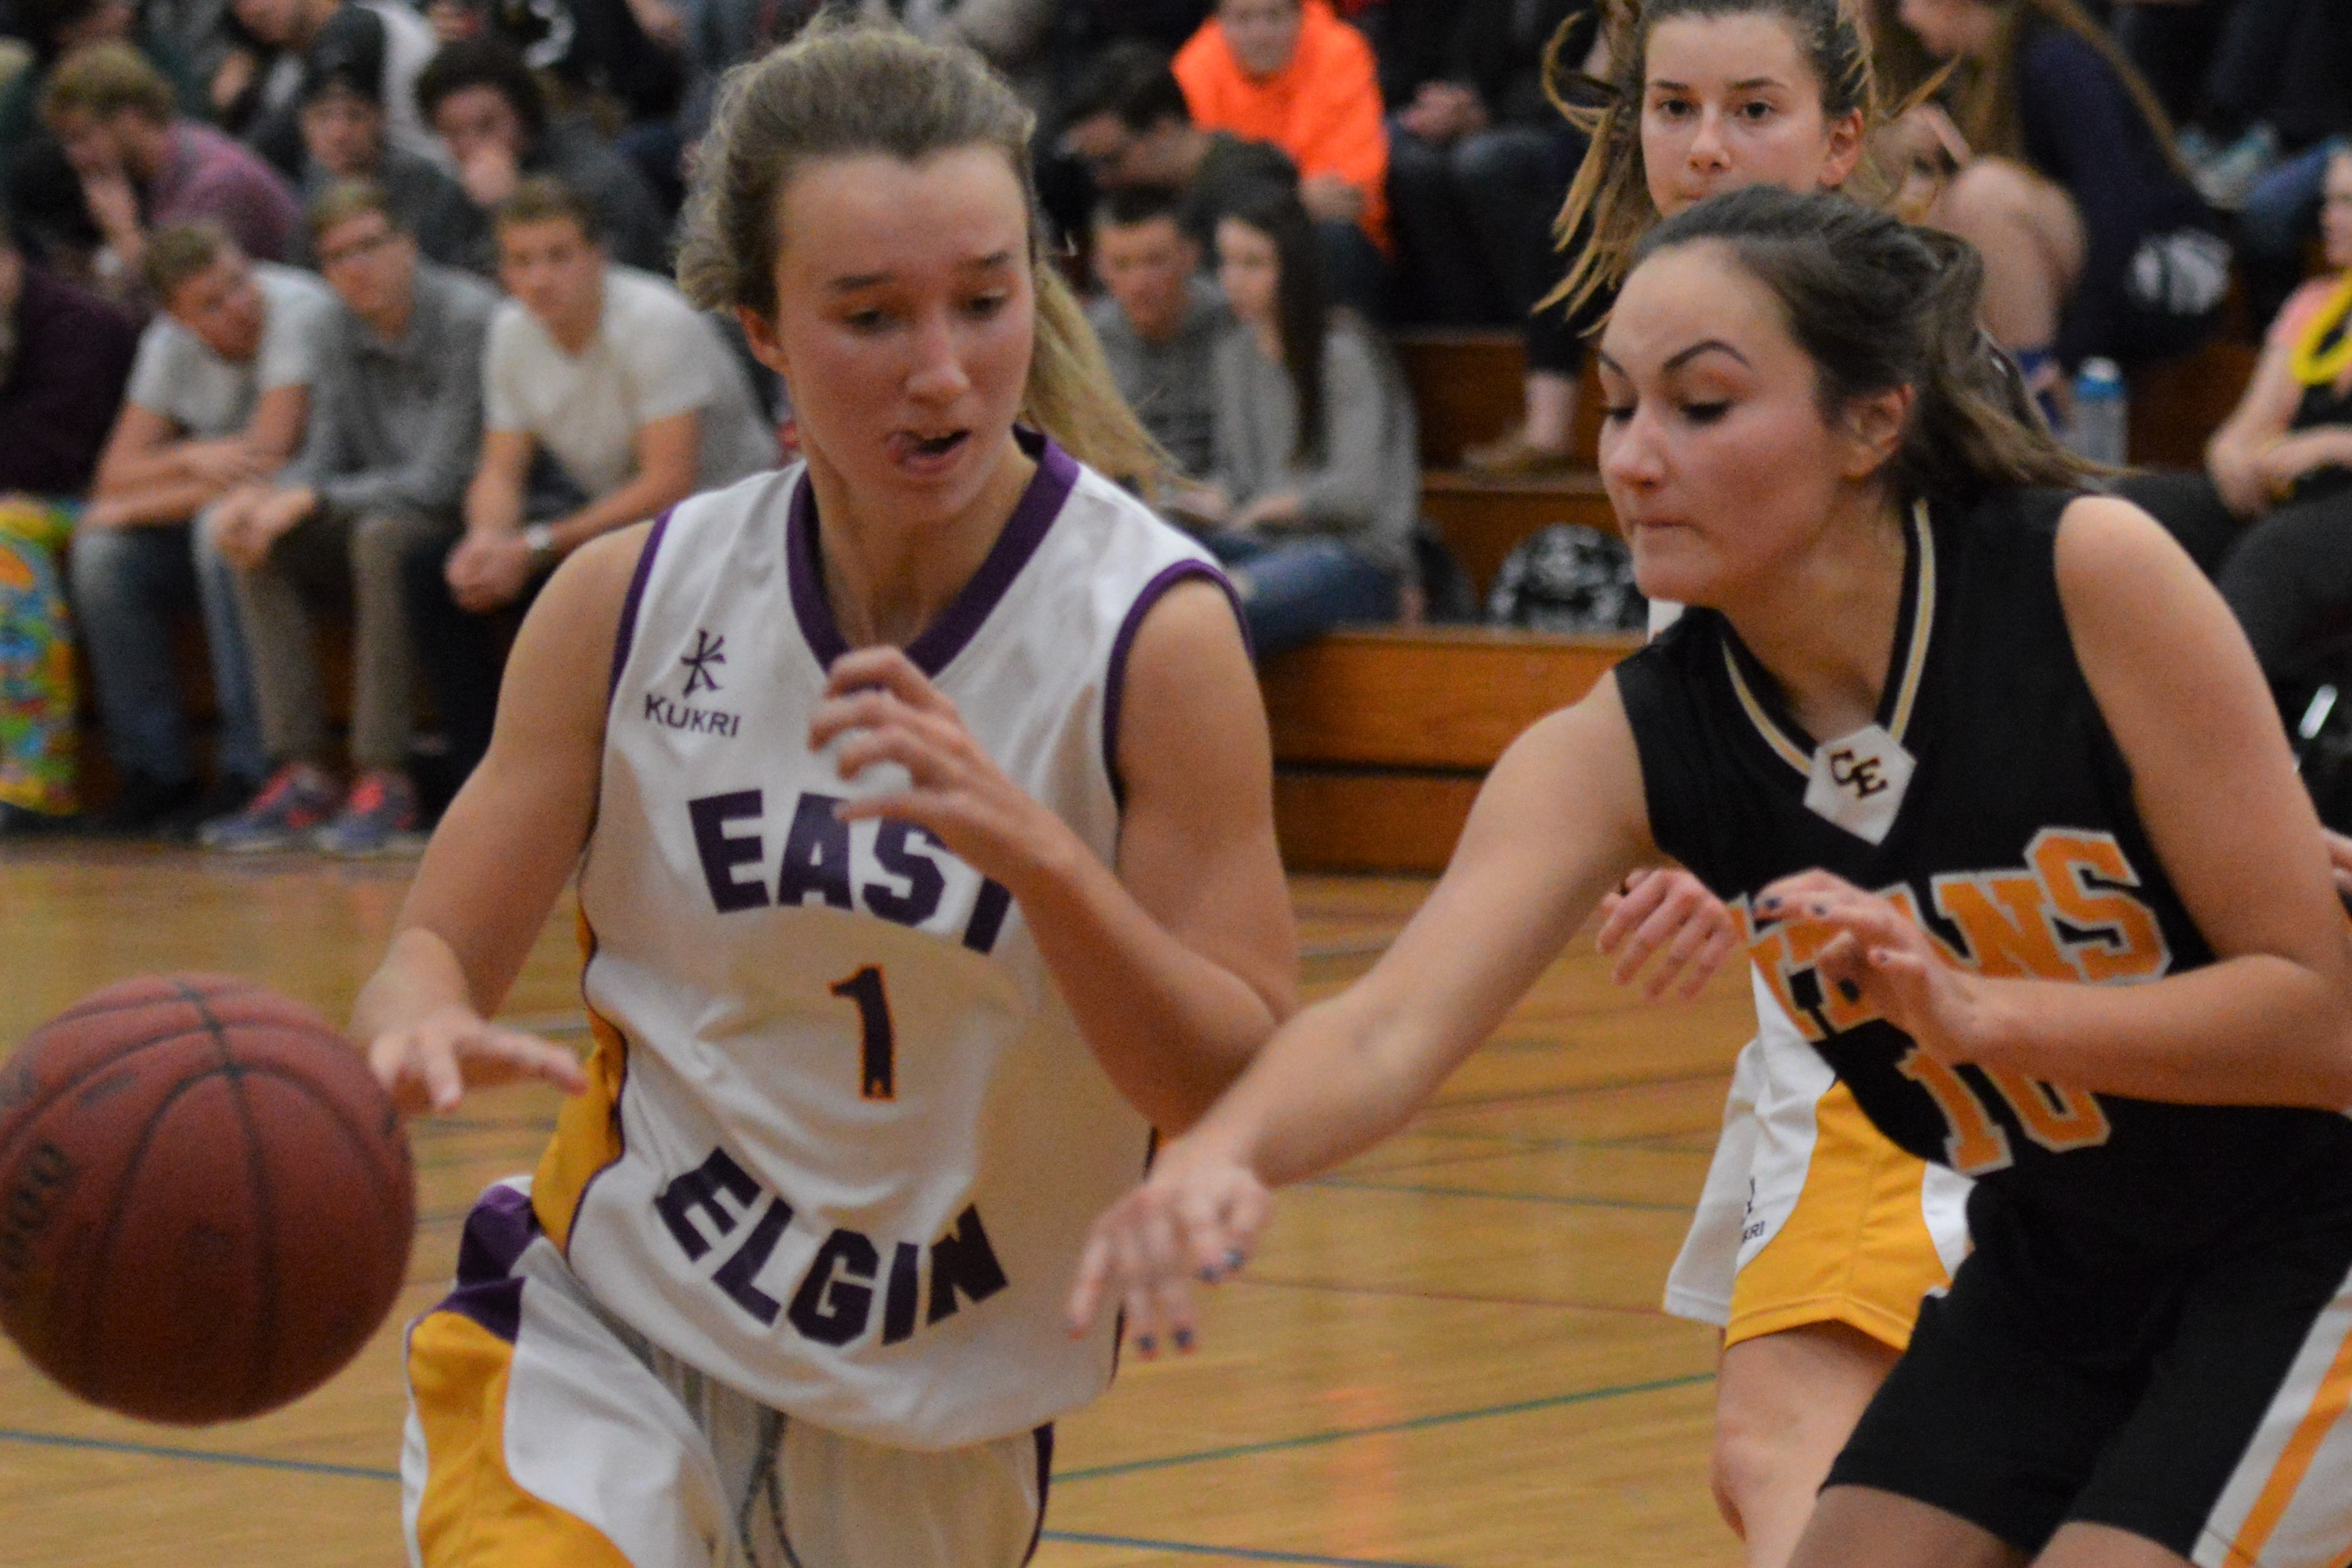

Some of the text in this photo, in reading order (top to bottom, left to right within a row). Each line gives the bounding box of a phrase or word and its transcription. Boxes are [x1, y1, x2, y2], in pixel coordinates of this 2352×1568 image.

[644, 693, 740, 738] KUKRI
[827, 963, 898, 1102] 1
[653, 1146, 1008, 1348] ELGIN
